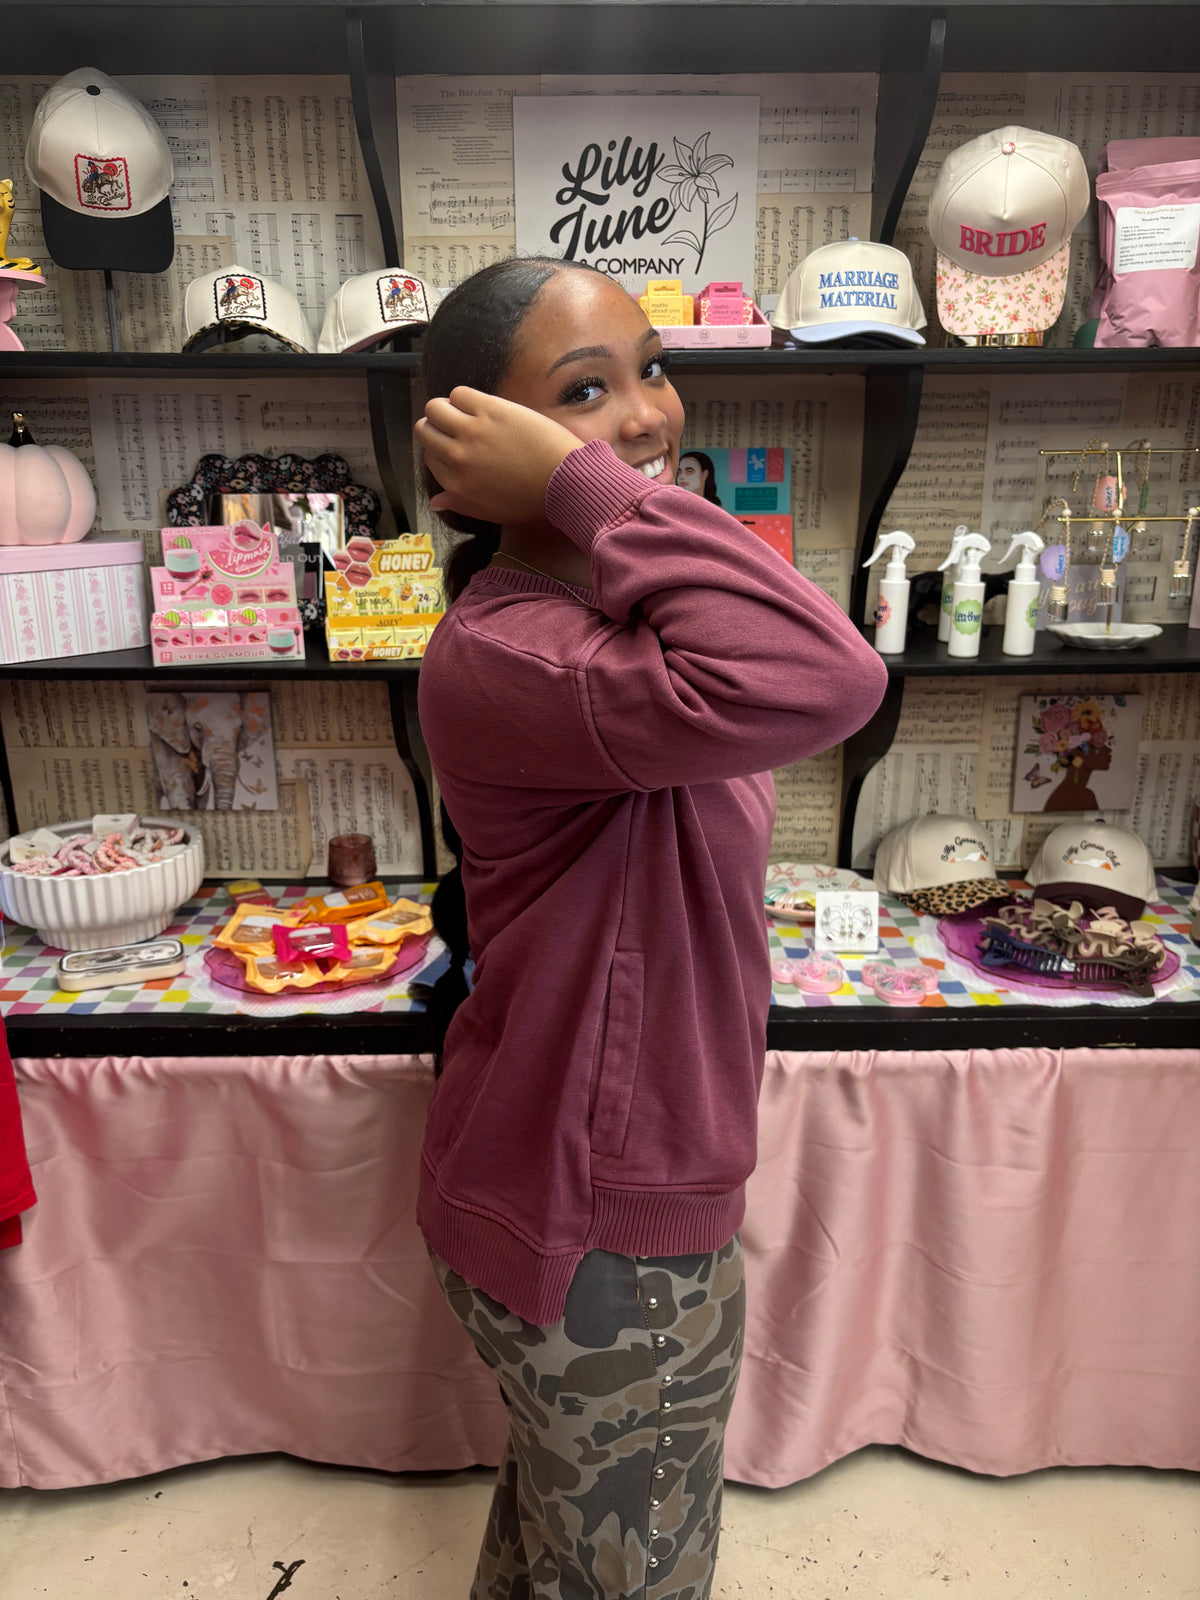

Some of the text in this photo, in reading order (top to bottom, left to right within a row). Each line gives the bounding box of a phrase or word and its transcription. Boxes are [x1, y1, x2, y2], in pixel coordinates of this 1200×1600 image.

[555, 135, 666, 206] Lily
[549, 198, 677, 261] June
[959, 222, 1047, 257] BRIDE
[594, 258, 685, 275] COMPANY
[818, 270, 900, 289] MARRIAGE
[820, 291, 897, 310] MATERIAL
[381, 554, 430, 570] HONEY
[162, 583, 173, 591] 12
[372, 648, 401, 656] HONEY
